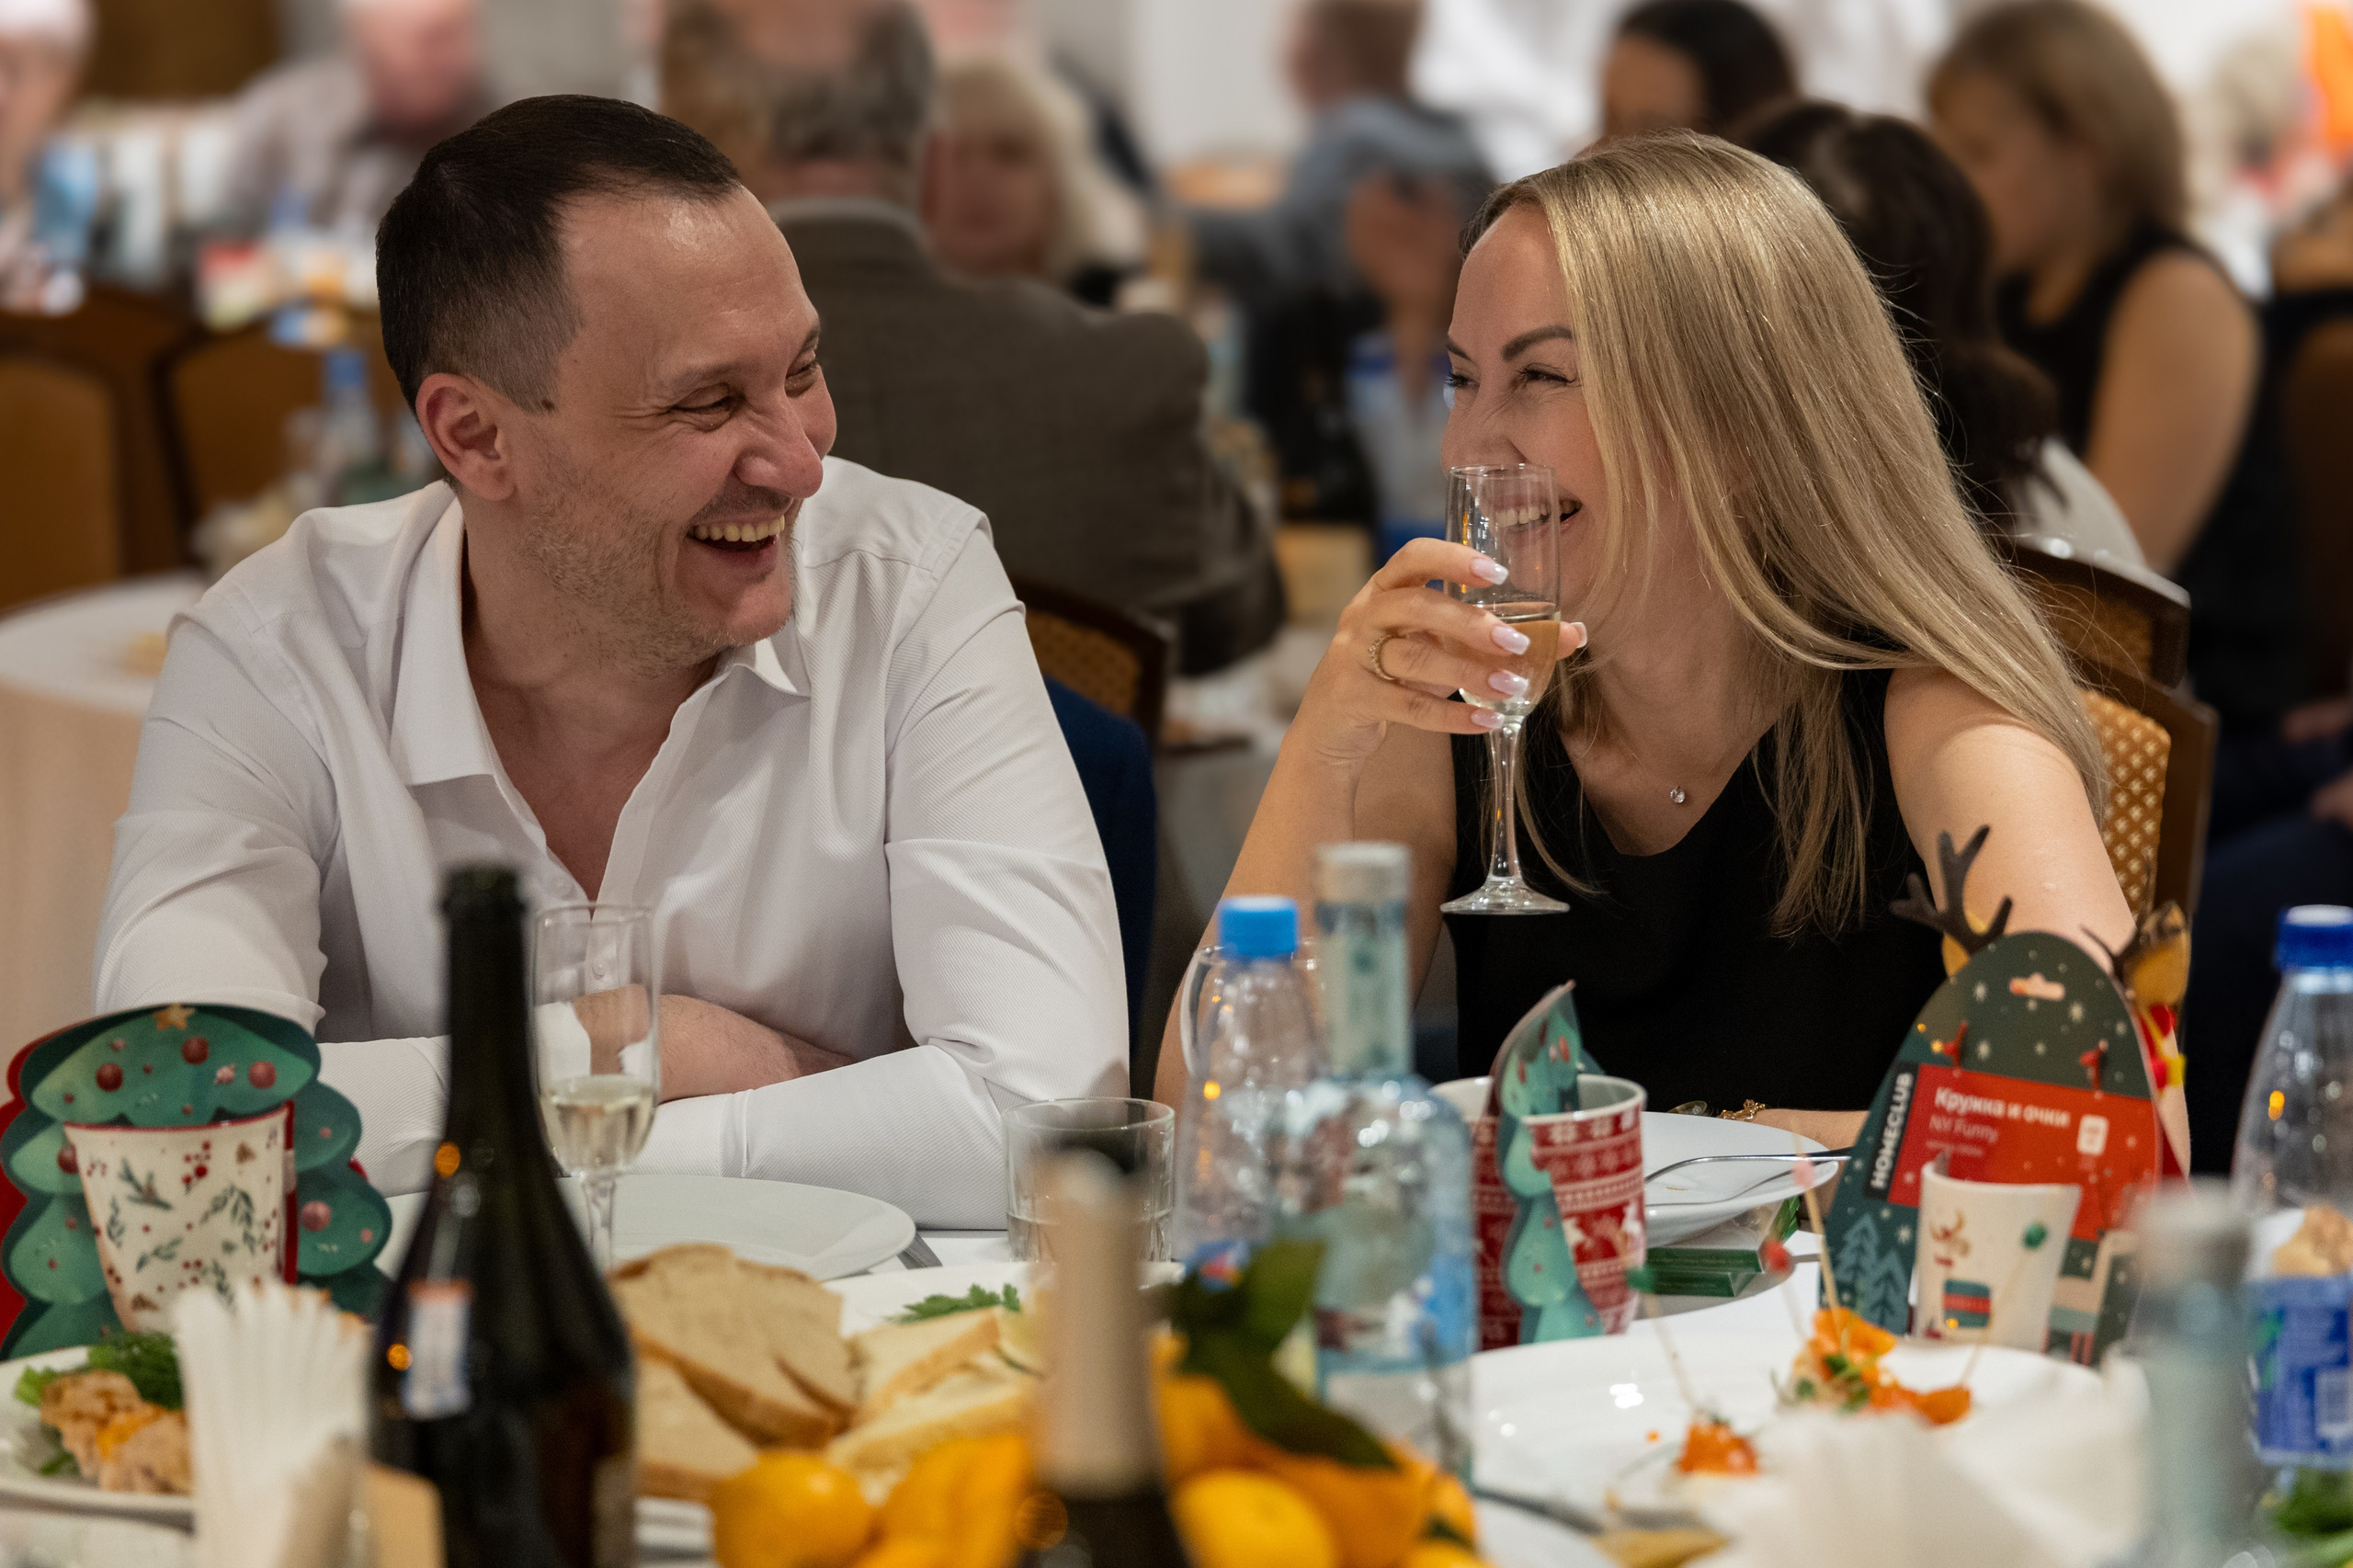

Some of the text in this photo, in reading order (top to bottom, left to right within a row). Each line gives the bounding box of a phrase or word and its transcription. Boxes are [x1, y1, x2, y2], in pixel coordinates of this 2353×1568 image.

[1935, 1086, 2071, 1128] Кружка и очки
[1870, 1072, 1914, 1188] HOMECLUB
[1929, 1114, 1998, 1143] NY Funny
